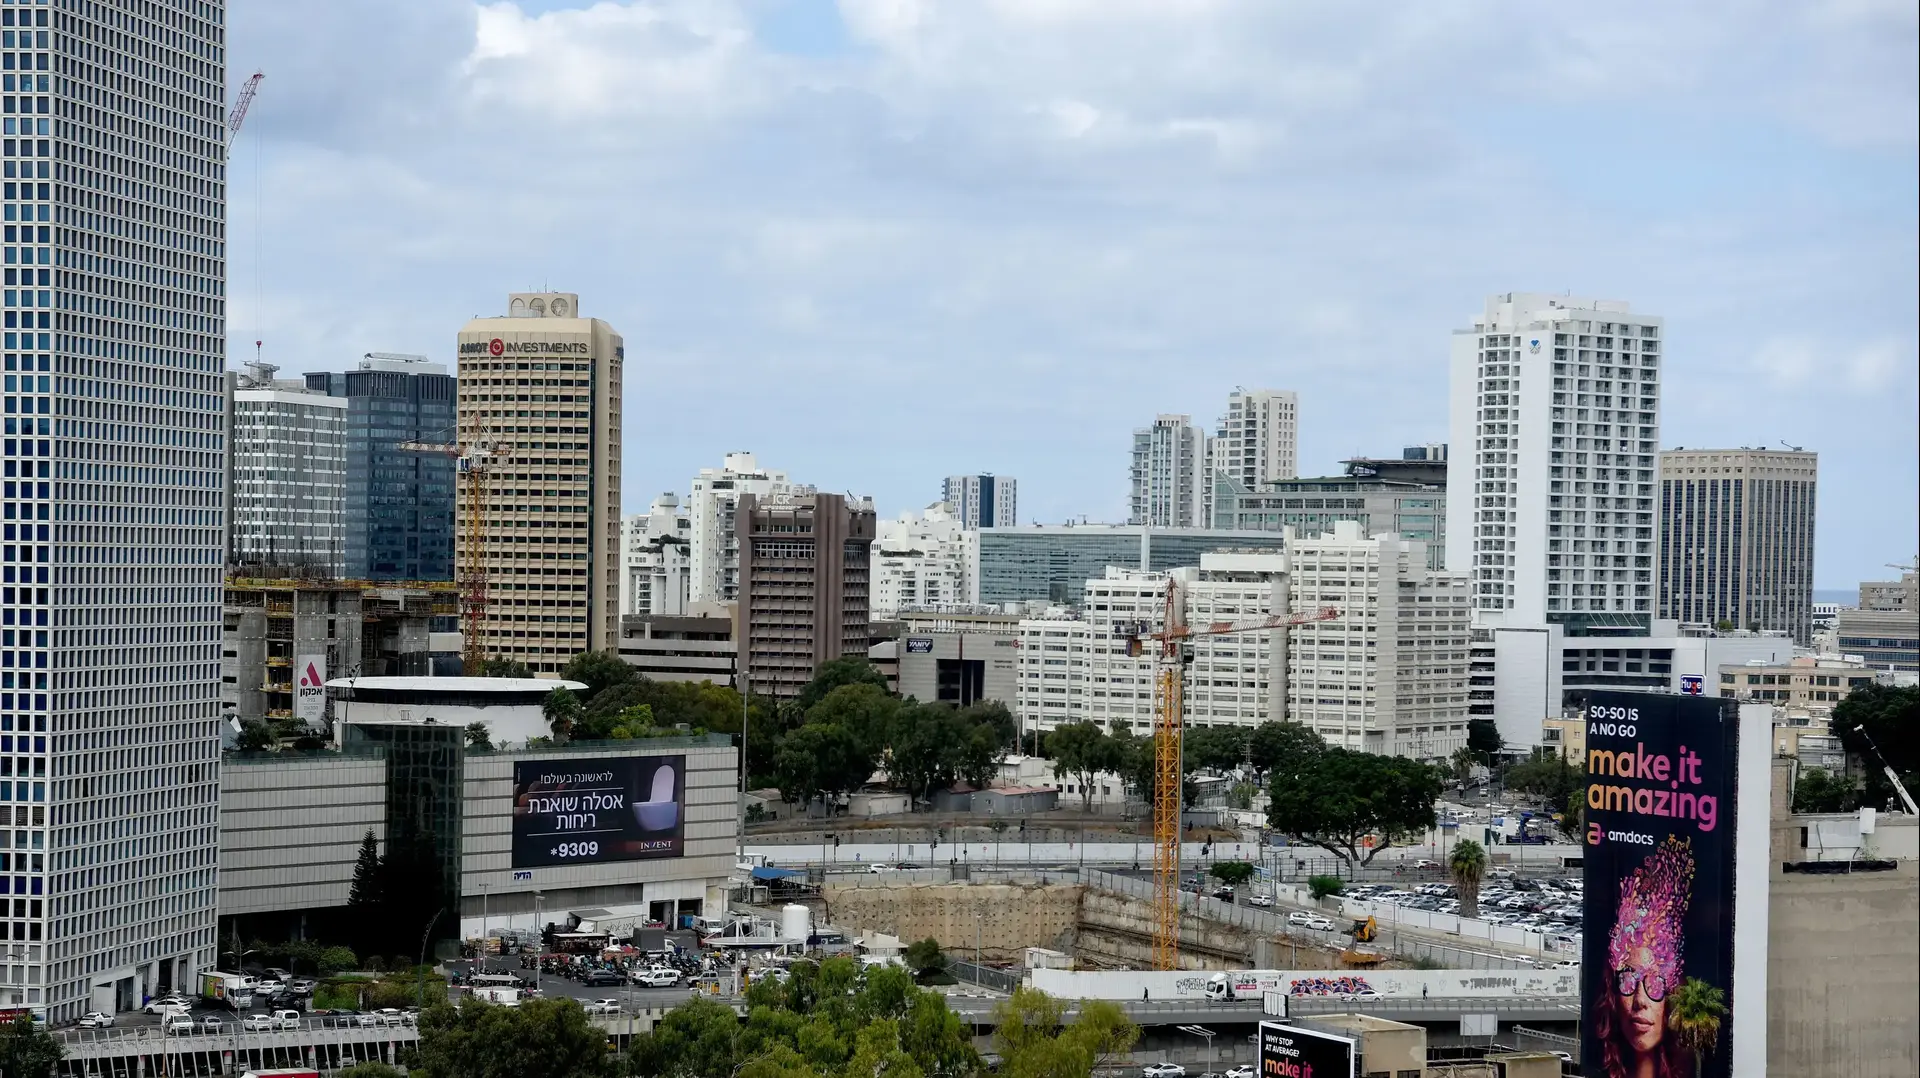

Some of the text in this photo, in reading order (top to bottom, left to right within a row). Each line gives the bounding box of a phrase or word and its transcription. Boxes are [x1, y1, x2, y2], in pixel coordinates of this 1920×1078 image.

[506, 342, 588, 353] INVESTMENTS
[300, 688, 323, 697] אפקון
[1681, 679, 1702, 694] Huge
[1590, 705, 1639, 721] SO-SO IS
[1589, 722, 1637, 738] A NO GO
[1589, 742, 1702, 784] make it
[540, 771, 613, 784] לראשונה בעולם!
[528, 792, 624, 814] אסלה שואבת
[1588, 780, 1717, 832] amazing
[556, 813, 596, 830] ריחות
[640, 840, 673, 849] INVENT
[1608, 831, 1654, 845] amdocs
[1265, 1034, 1294, 1047] WHY STOP
[1265, 1043, 1300, 1058] AT AVERAGE?
[1265, 1057, 1313, 1078] make it
